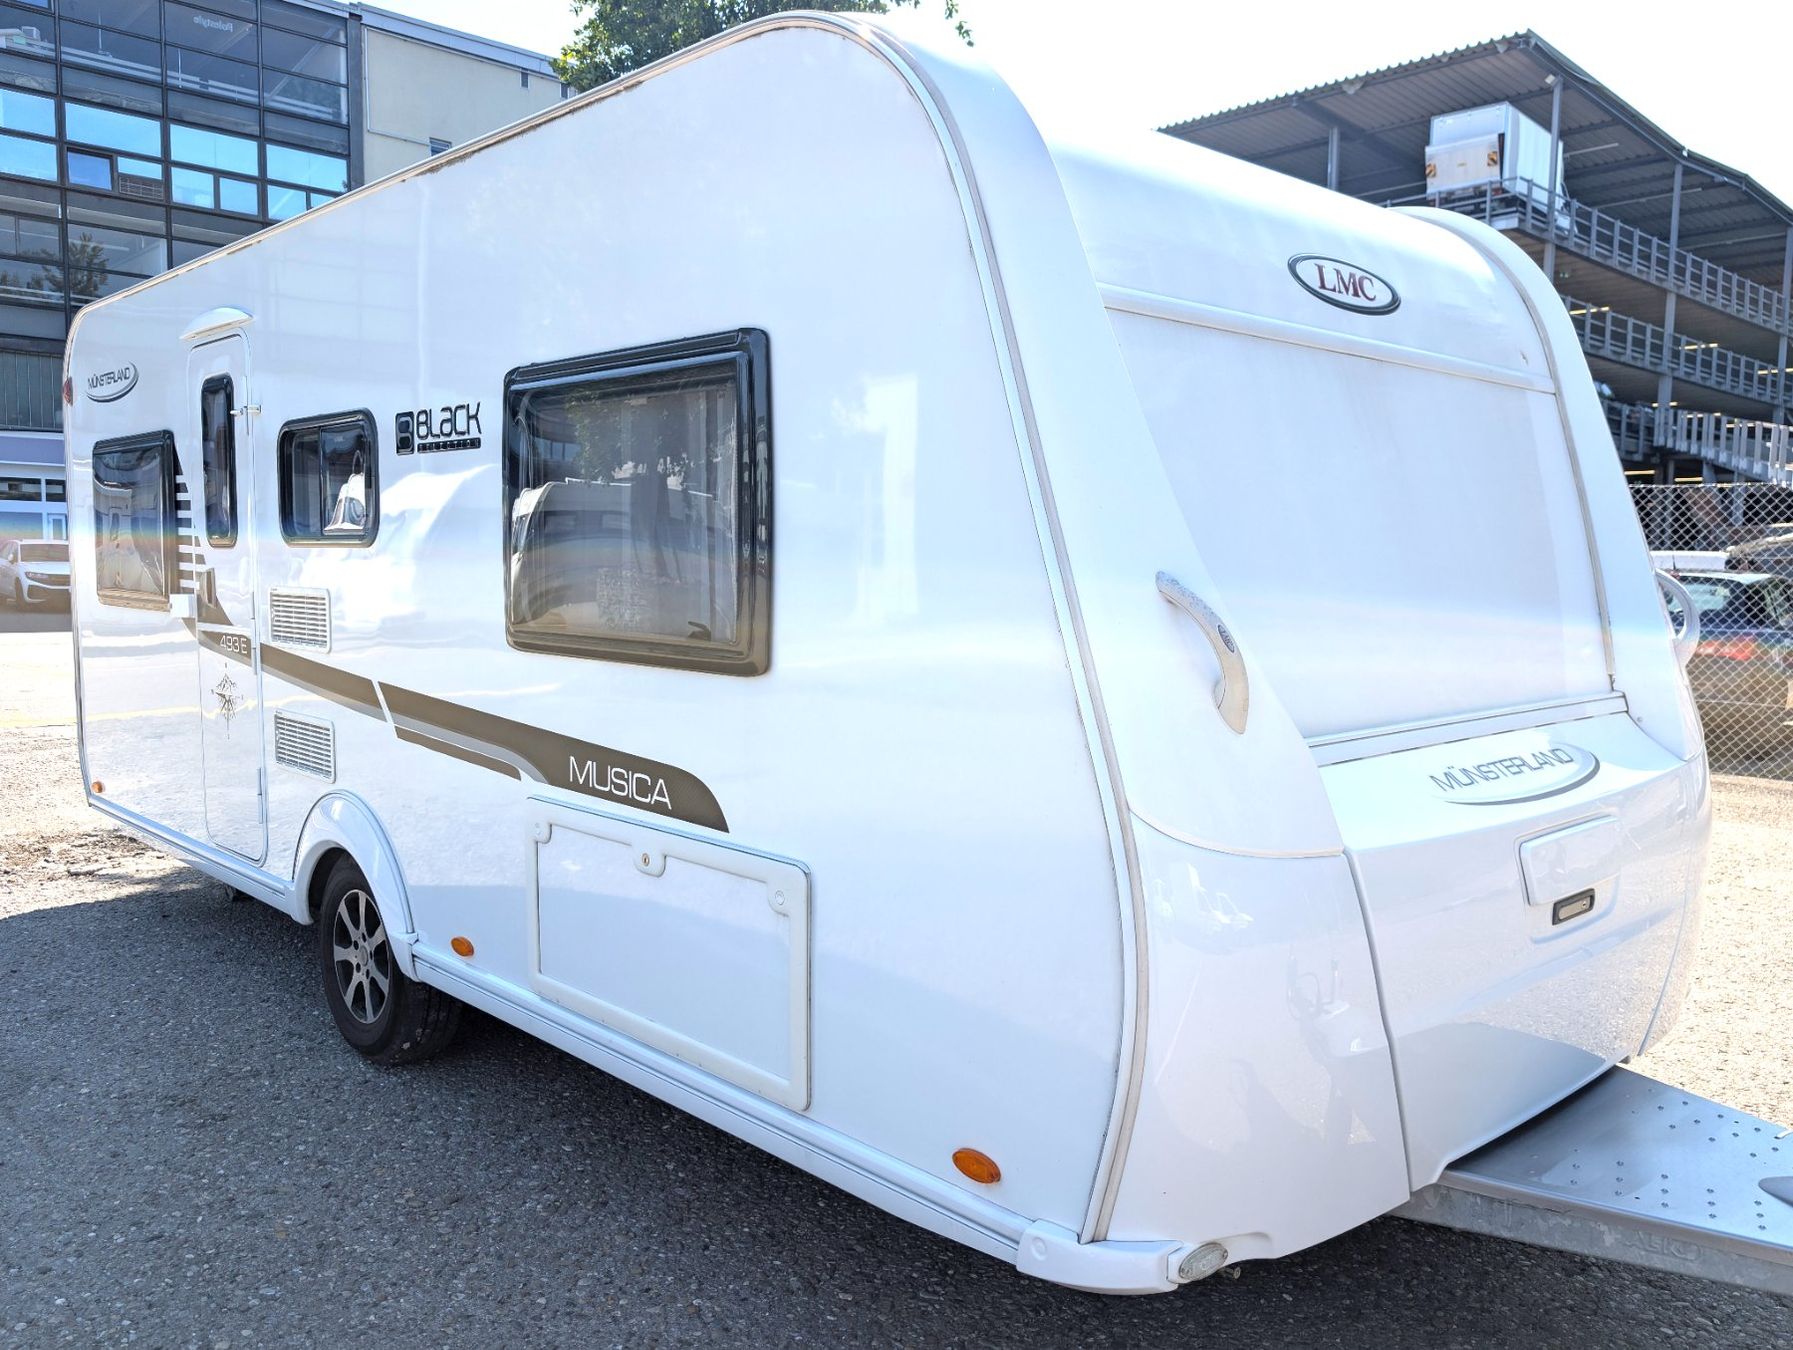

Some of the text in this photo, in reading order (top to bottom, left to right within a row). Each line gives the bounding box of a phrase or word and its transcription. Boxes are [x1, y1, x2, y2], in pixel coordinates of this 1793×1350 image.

[1314, 262, 1377, 302] LMC
[220, 635, 248, 654] 493 E
[569, 755, 672, 810] MUSICA
[1429, 748, 1574, 792] MÜNSTERLAND
